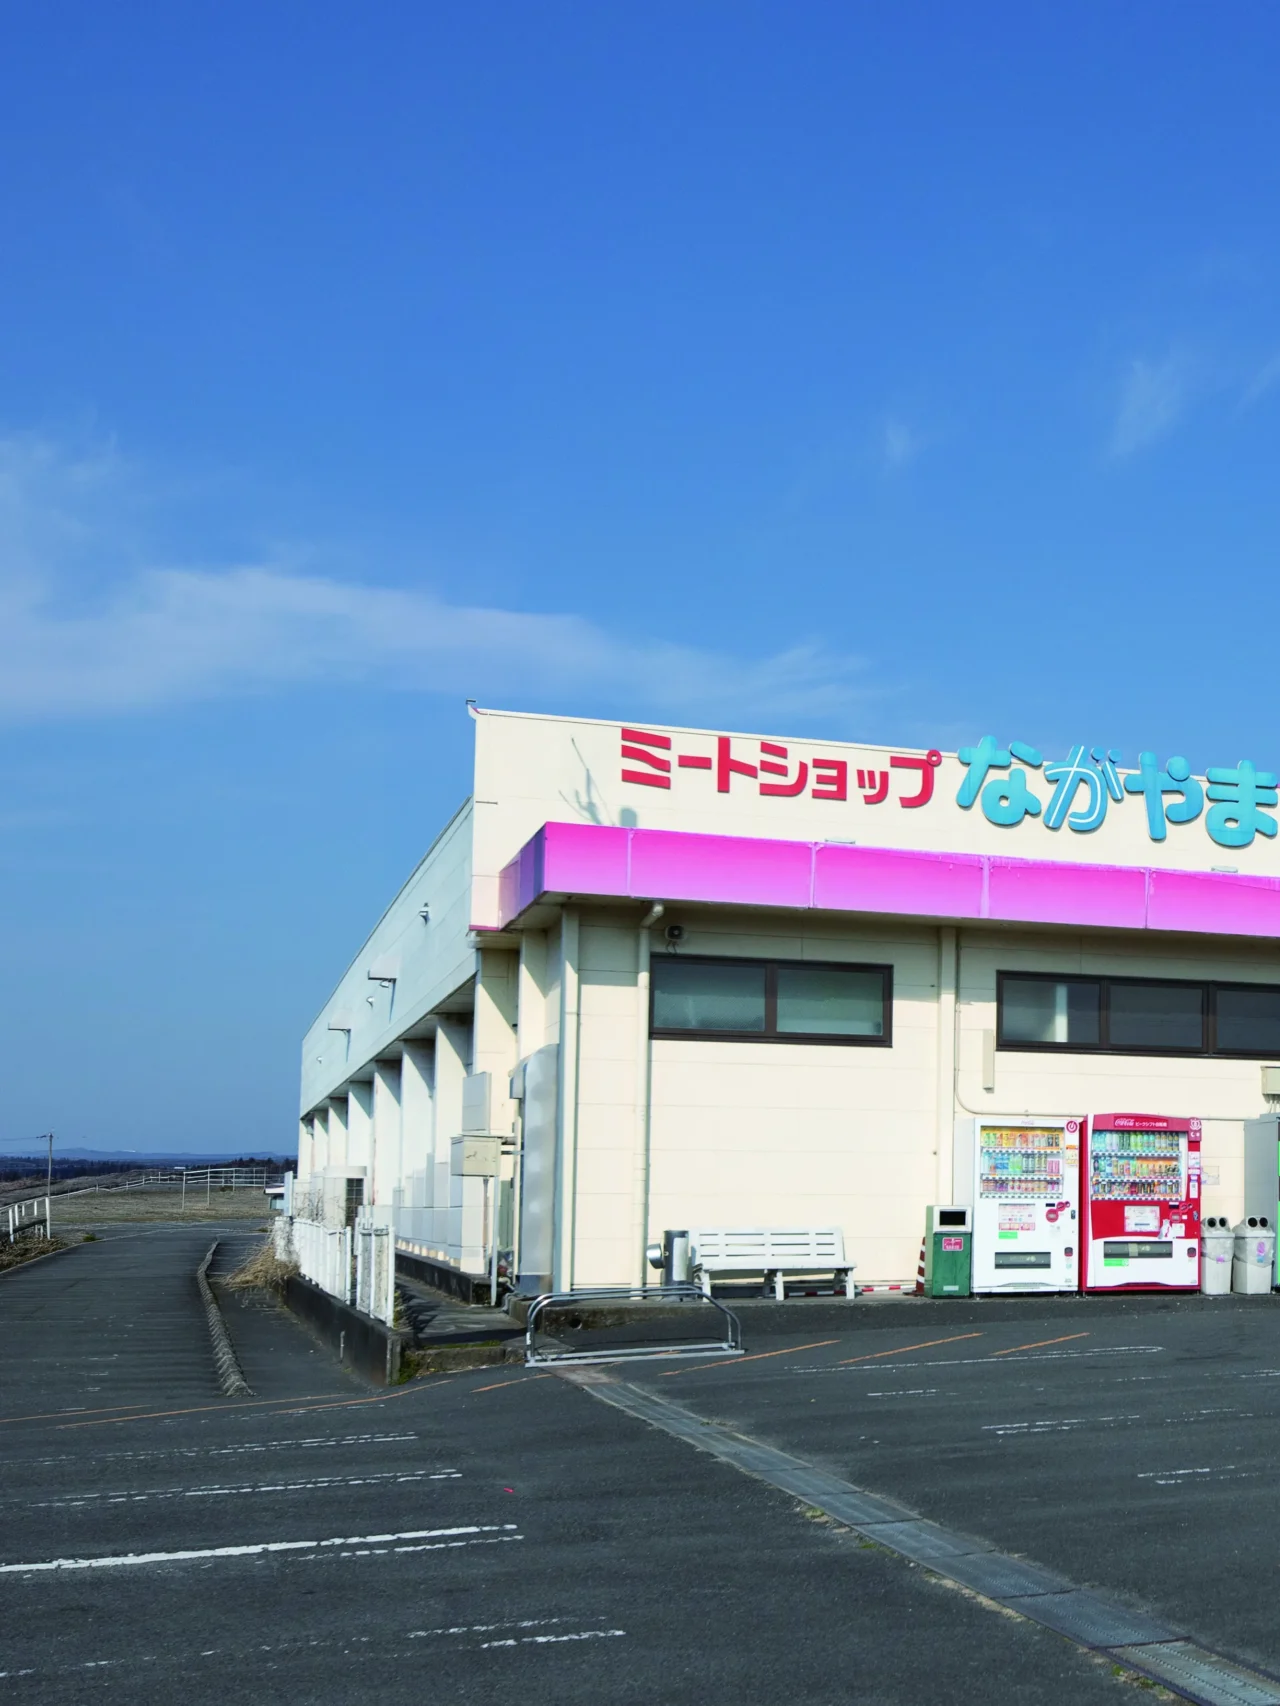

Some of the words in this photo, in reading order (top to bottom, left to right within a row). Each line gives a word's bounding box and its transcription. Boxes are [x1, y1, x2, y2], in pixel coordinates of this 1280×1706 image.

[622, 728, 942, 809] ミートショップ
[956, 735, 1279, 847] ながやま
